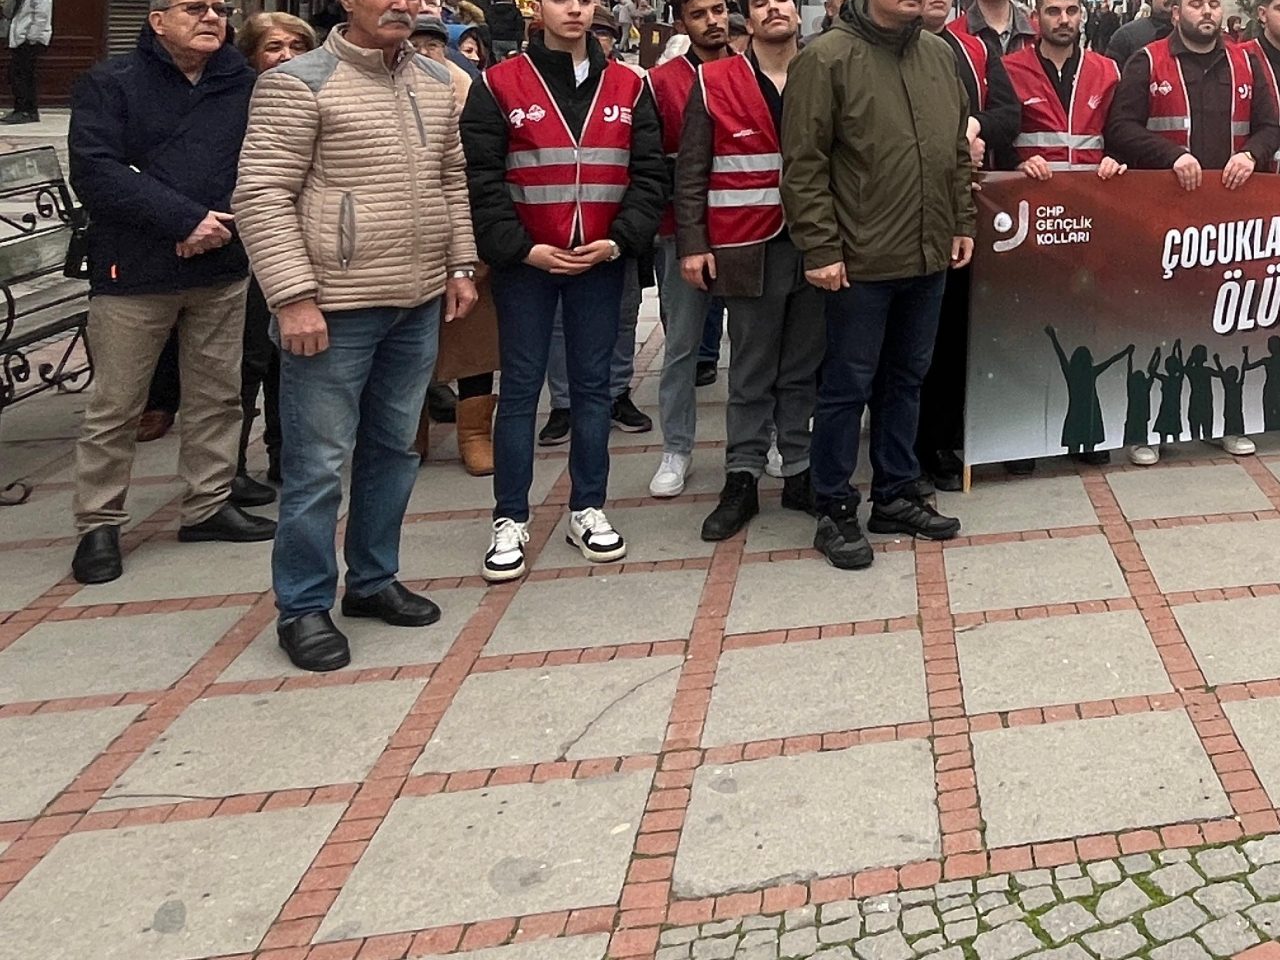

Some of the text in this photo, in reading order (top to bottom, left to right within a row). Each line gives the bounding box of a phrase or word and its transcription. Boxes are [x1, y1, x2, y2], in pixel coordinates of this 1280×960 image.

[1036, 205, 1065, 218] CHP
[1035, 215, 1092, 232] GENÇLİK
[1036, 231, 1090, 245] KOLLARI
